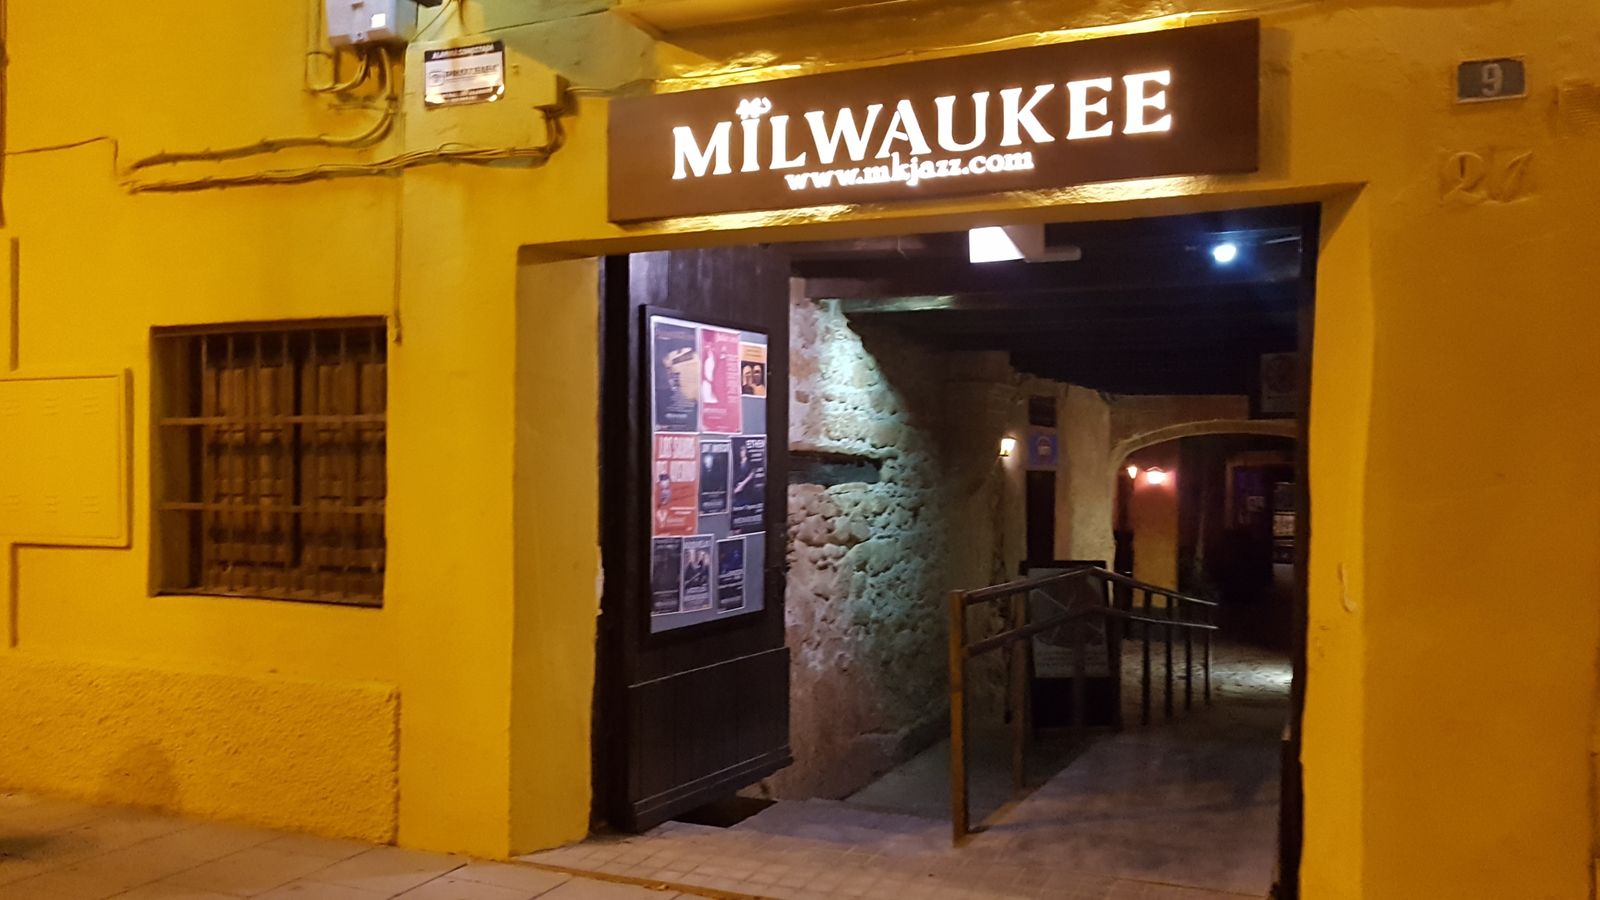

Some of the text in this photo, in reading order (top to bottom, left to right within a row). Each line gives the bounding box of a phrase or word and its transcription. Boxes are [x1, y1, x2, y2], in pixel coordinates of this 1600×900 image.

[1481, 63, 1503, 97] 9
[671, 70, 1172, 180] MILWAUKEE
[784, 151, 1035, 190] www.mkjazz.com
